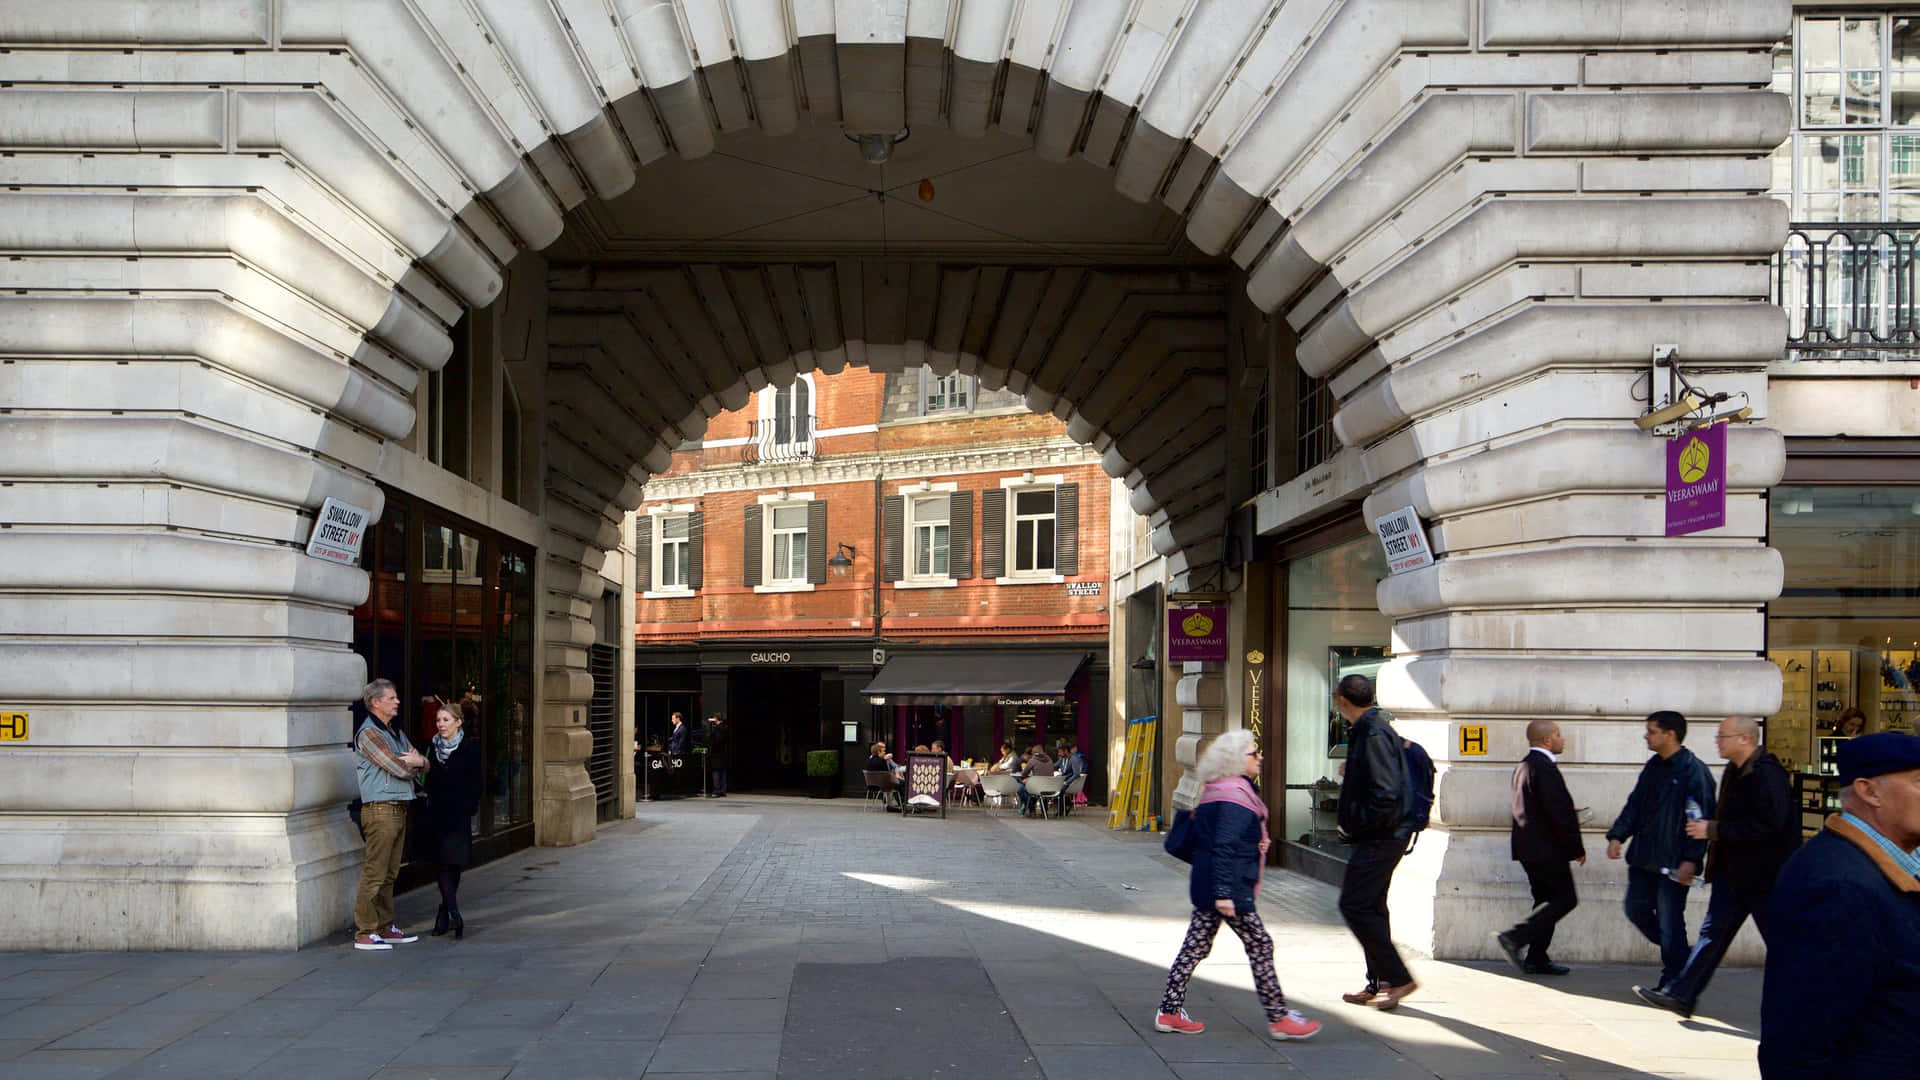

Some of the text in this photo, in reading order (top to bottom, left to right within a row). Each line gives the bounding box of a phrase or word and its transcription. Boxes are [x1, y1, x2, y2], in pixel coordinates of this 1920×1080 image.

[1667, 479, 1719, 503] VEERASWAMY
[328, 505, 362, 528] SWALLOW
[1379, 516, 1409, 538] SWALLOW
[321, 523, 360, 546] STREET W1
[1386, 532, 1421, 555] STREET W1
[750, 652, 791, 662] GAUCHO
[1464, 728, 1483, 752] H
[651, 759, 682, 769] GAHO
